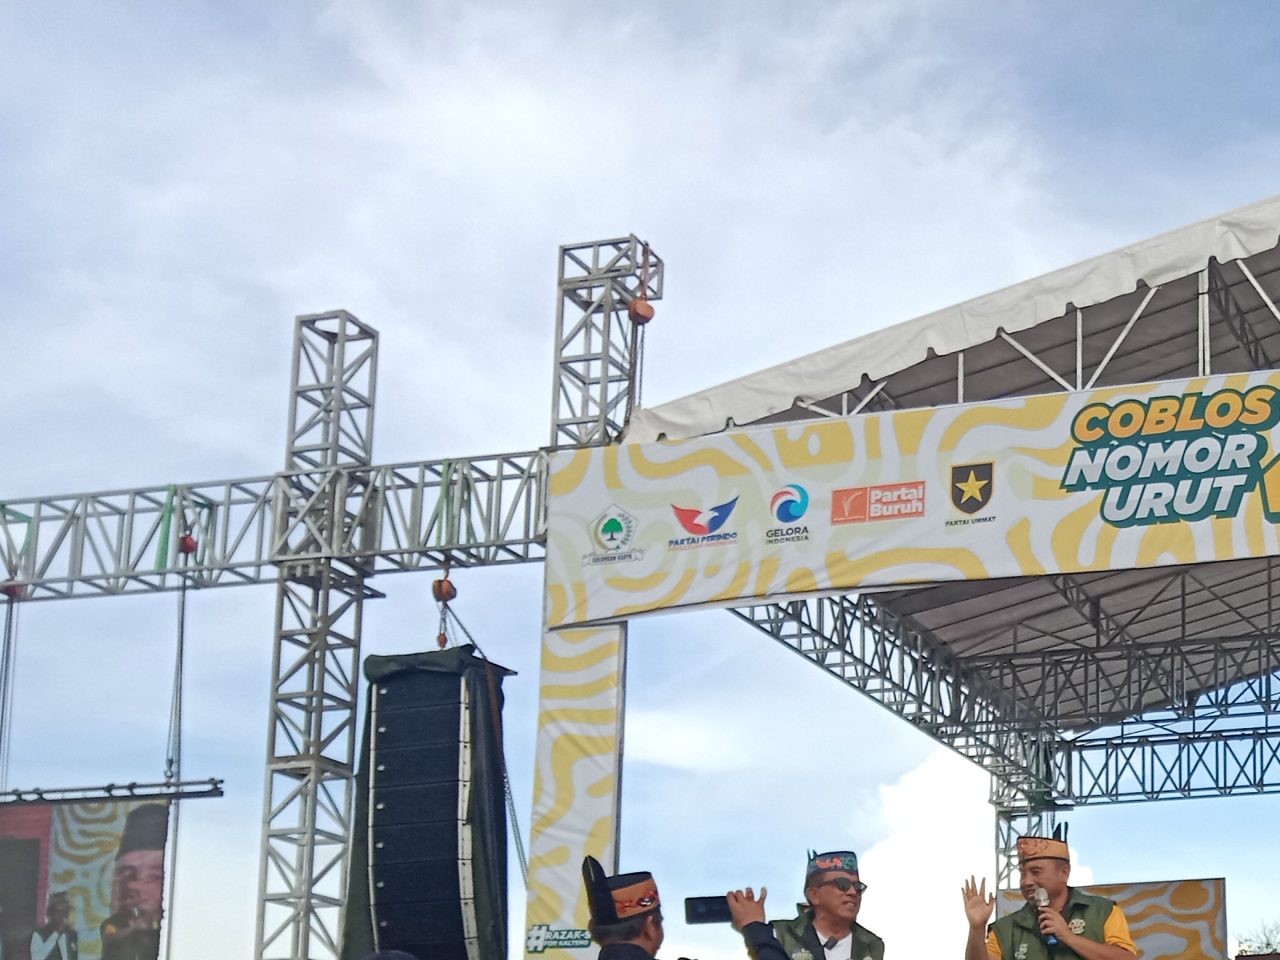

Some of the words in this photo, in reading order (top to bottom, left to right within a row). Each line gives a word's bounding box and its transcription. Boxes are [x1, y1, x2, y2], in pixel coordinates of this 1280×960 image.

[1073, 389, 1277, 442] COBLOS
[1066, 432, 1259, 487] NOMOR
[870, 485, 923, 503] Partai
[1103, 473, 1249, 522] URUT
[869, 500, 923, 517] Buruh
[667, 536, 700, 547] PARTAI
[700, 532, 738, 543] PERINDO
[766, 526, 809, 539] GELORA
[527, 925, 592, 952] #RAZAK-S
